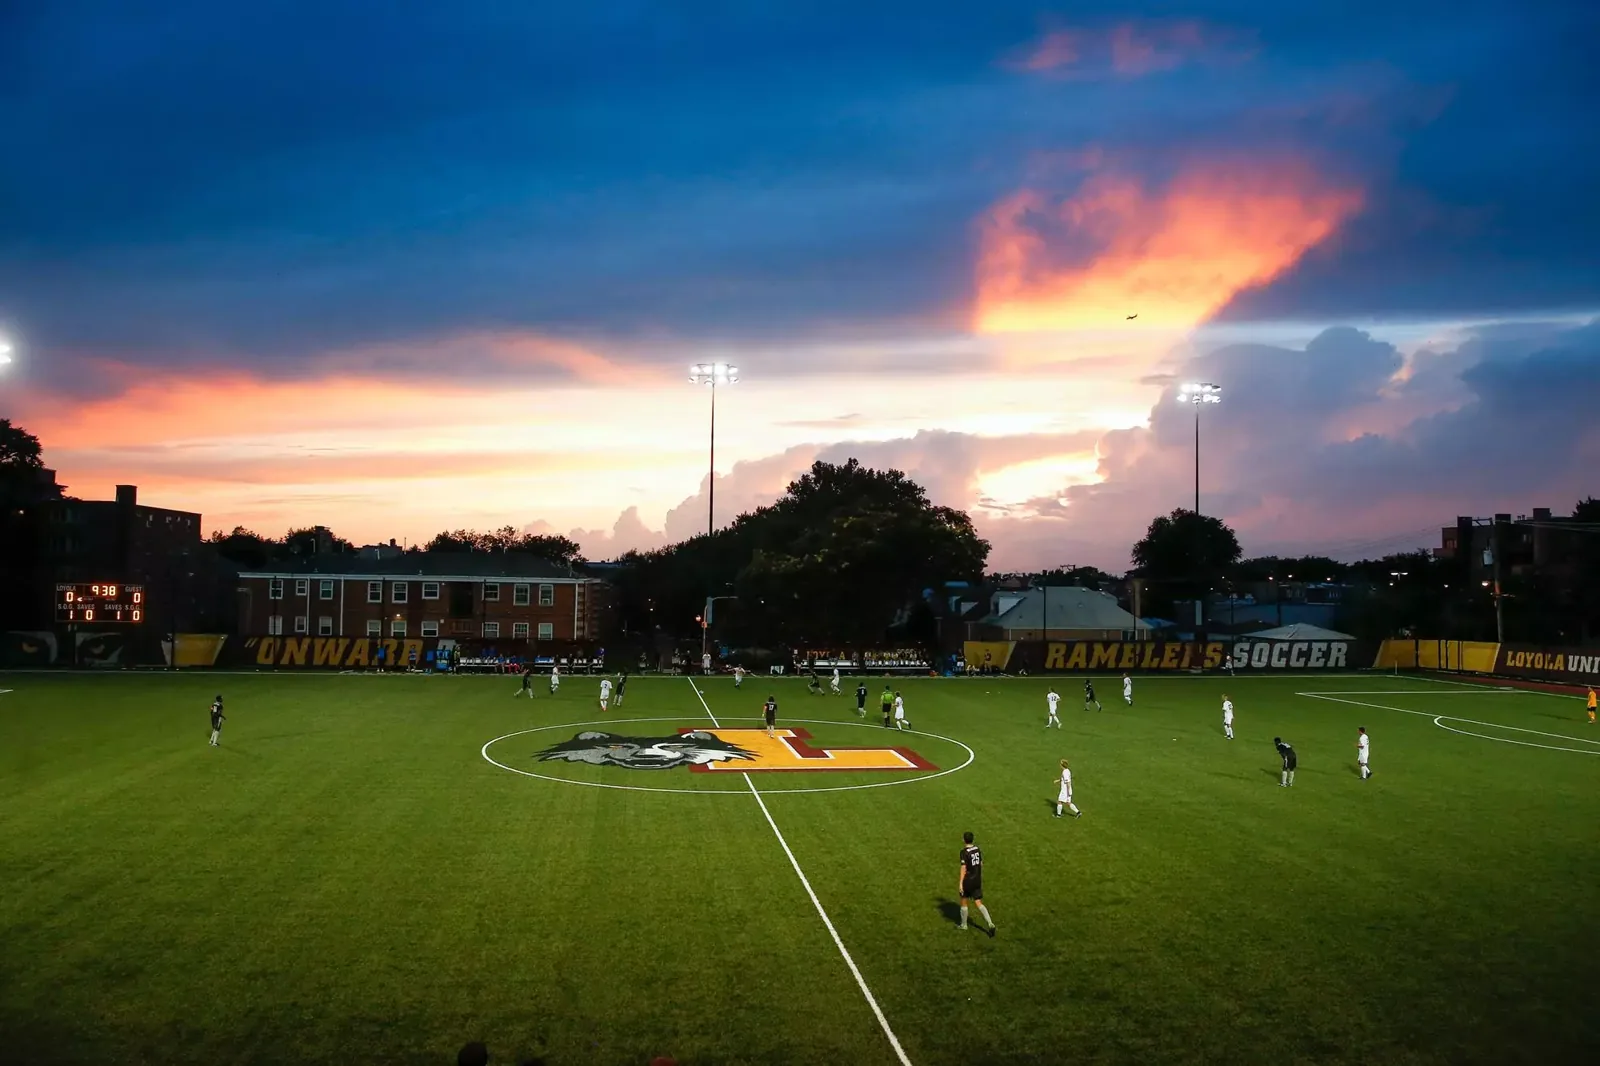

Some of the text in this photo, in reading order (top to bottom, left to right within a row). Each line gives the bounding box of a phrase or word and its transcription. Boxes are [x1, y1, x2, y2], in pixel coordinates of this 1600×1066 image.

[66, 592, 74, 602] 0
[133, 592, 141, 603] 0
[85, 609, 93, 620] 0
[132, 610, 140, 621] 0
[1233, 642, 1347, 668] SOCCER
[1506, 650, 1565, 671] LOYOLA
